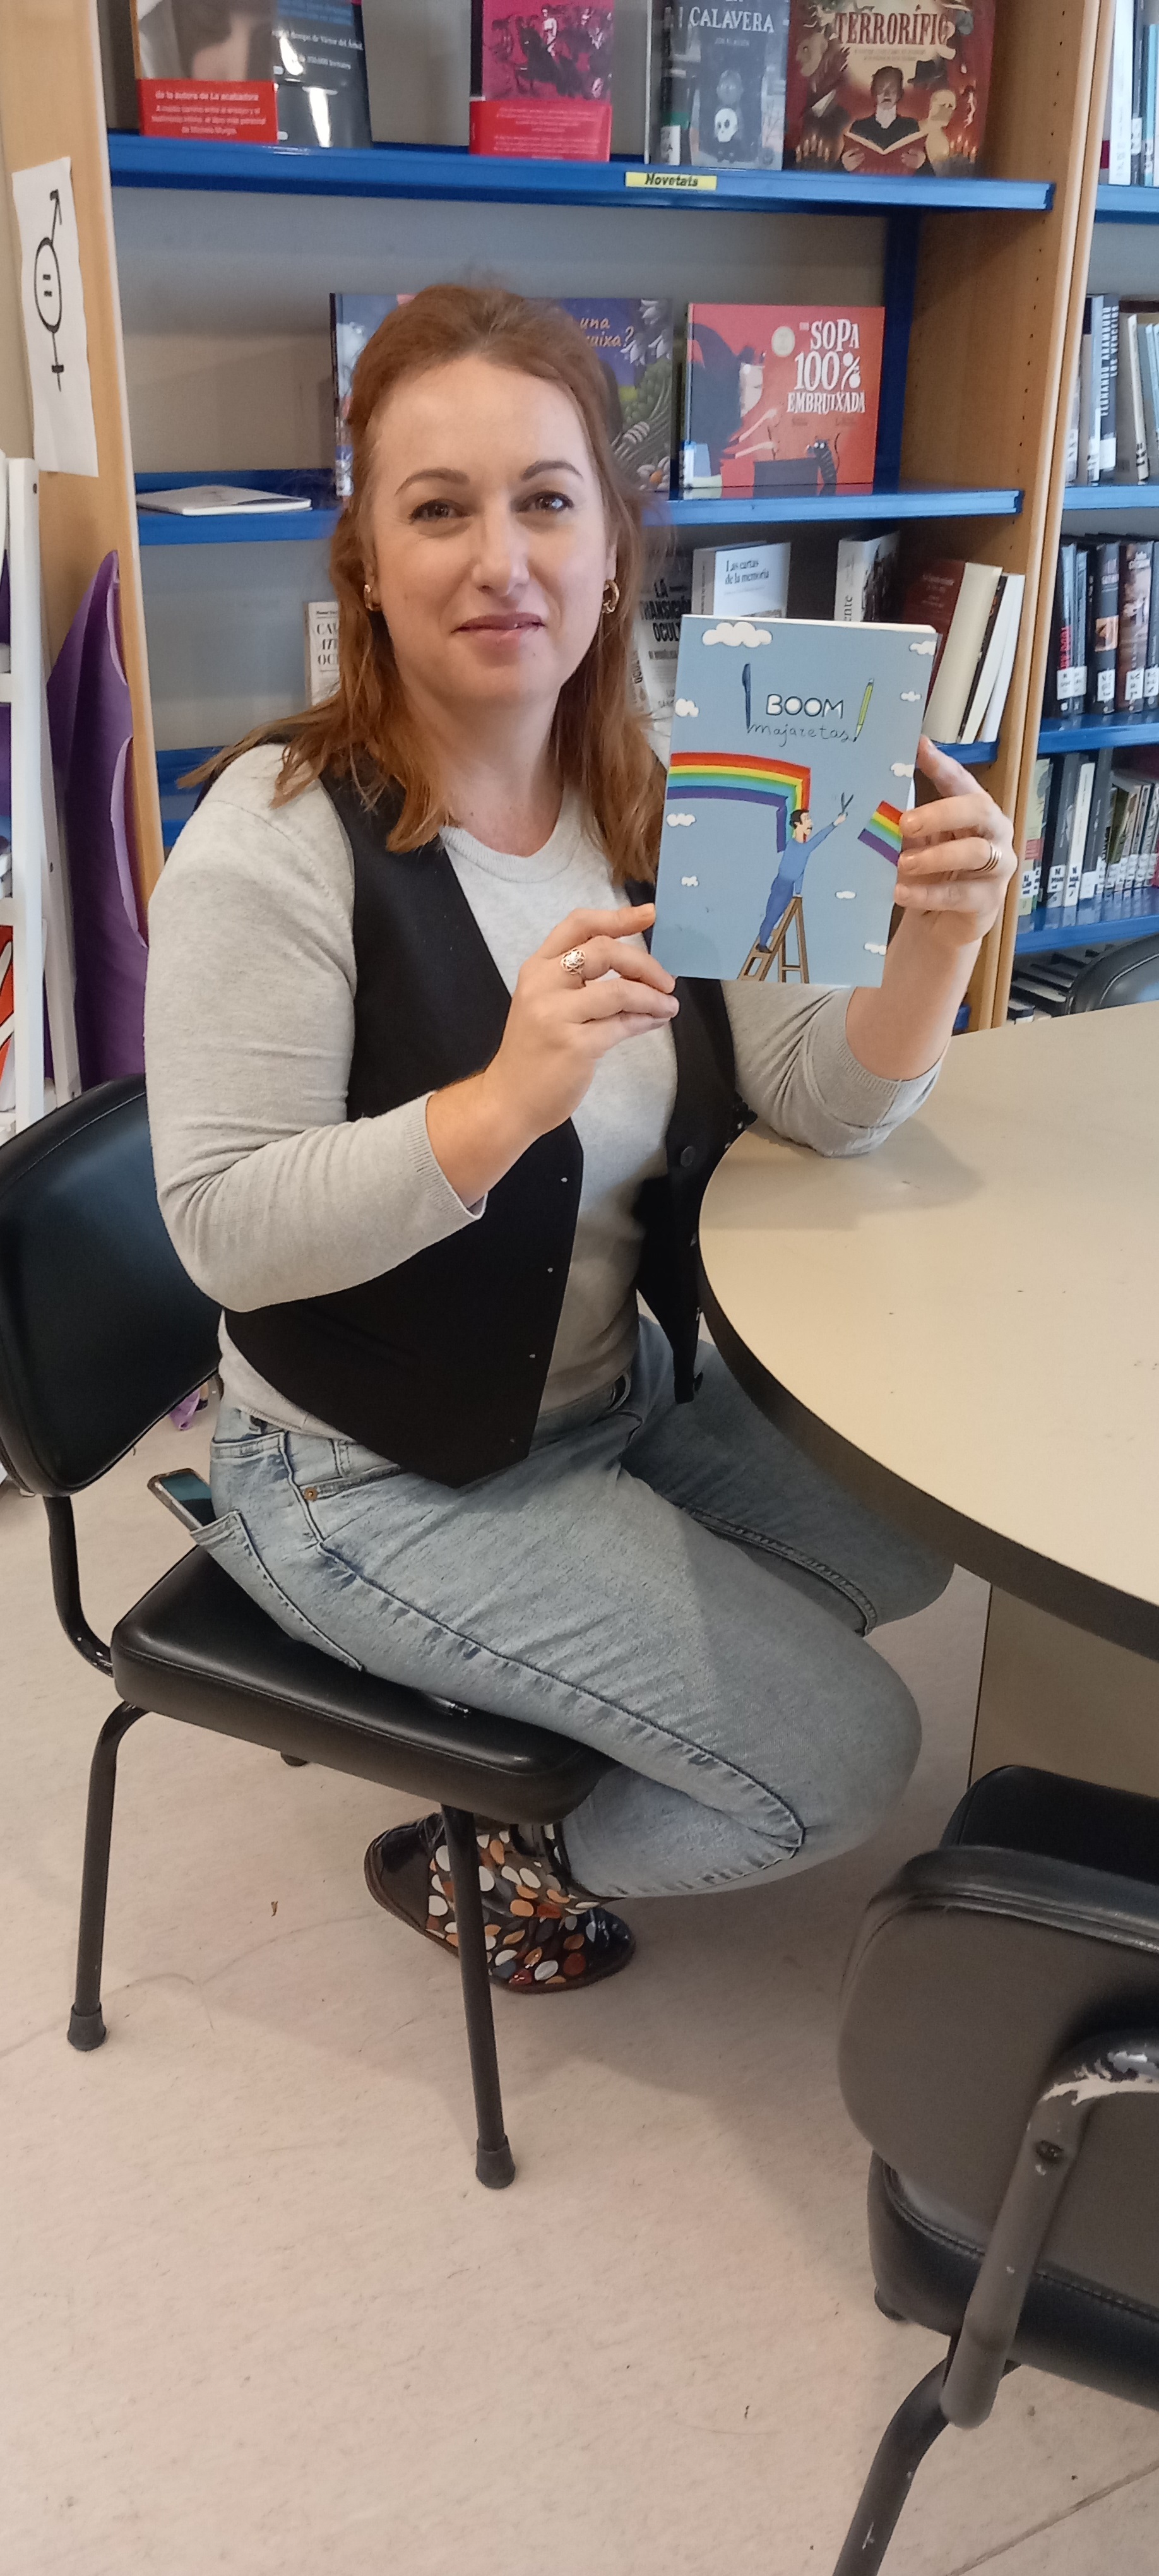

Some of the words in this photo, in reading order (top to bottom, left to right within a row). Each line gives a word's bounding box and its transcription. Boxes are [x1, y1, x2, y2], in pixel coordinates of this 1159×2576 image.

[689, 6, 774, 33] CALAVERA
[645, 172, 698, 187] Novetats
[580, 318, 610, 330] una
[811, 318, 860, 352] SOPA
[793, 350, 861, 391] 100%
[787, 390, 865, 415] EMBRUIXADA
[725, 573, 733, 585] de
[734, 572, 740, 584] la
[727, 560, 739, 572] Las
[653, 622, 682, 642] OCULT
[766, 693, 844, 719] BOOM
[747, 723, 853, 748] majaretas
